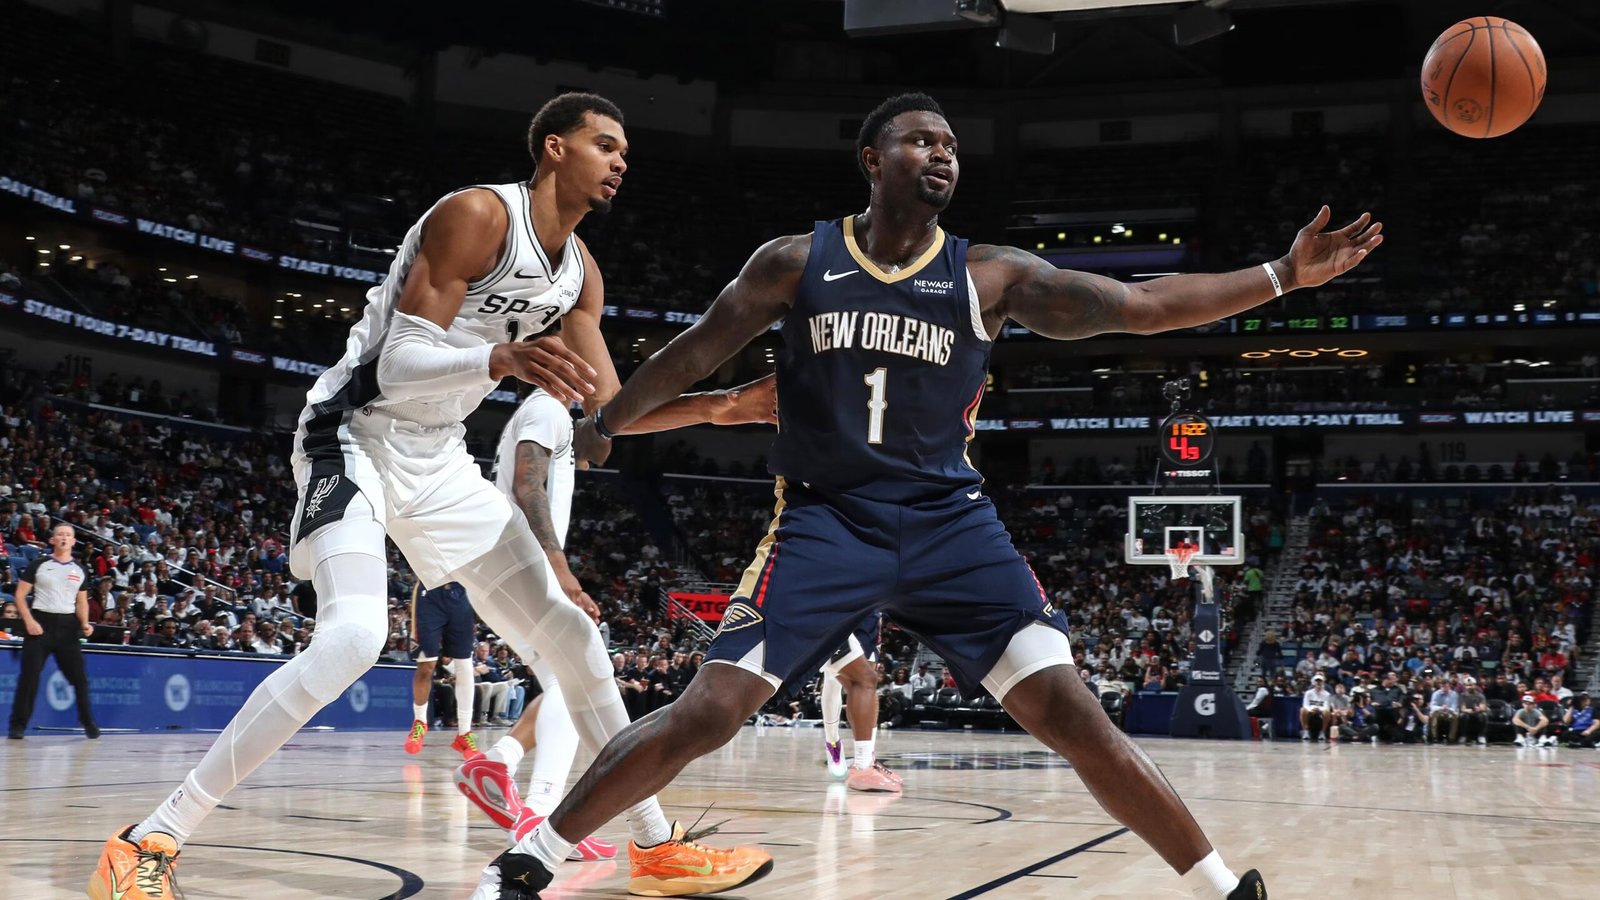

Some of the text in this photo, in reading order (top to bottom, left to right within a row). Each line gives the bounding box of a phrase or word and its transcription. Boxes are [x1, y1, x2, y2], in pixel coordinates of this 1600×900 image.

[32, 188, 77, 213] TRIAL
[136, 218, 197, 244] WATCH
[200, 235, 235, 254] LIVE
[279, 255, 331, 275] START
[332, 265, 377, 282] YOUR
[914, 279, 954, 289] NEWAGE
[920, 287, 947, 295] GARAGE
[24, 299, 73, 324] START
[74, 313, 117, 336] YOUR
[116, 324, 169, 346] 7-DAY
[170, 335, 218, 356] TRIAL
[1244, 319, 1262, 331] 27
[1330, 316, 1348, 329] 32
[808, 310, 955, 366] NEW ORLEANS
[863, 367, 888, 444] 1
[1050, 418, 1109, 430] WATCH
[1113, 417, 1150, 429] LIVE
[1254, 415, 1301, 427] YOUR
[1302, 414, 1353, 426] 7-DAY
[1354, 413, 1404, 425] TRIAL
[1464, 412, 1529, 424] WATCH
[1533, 411, 1575, 423] LIVE
[1177, 469, 1212, 477] TISSOT
[1195, 693, 1216, 716] G
